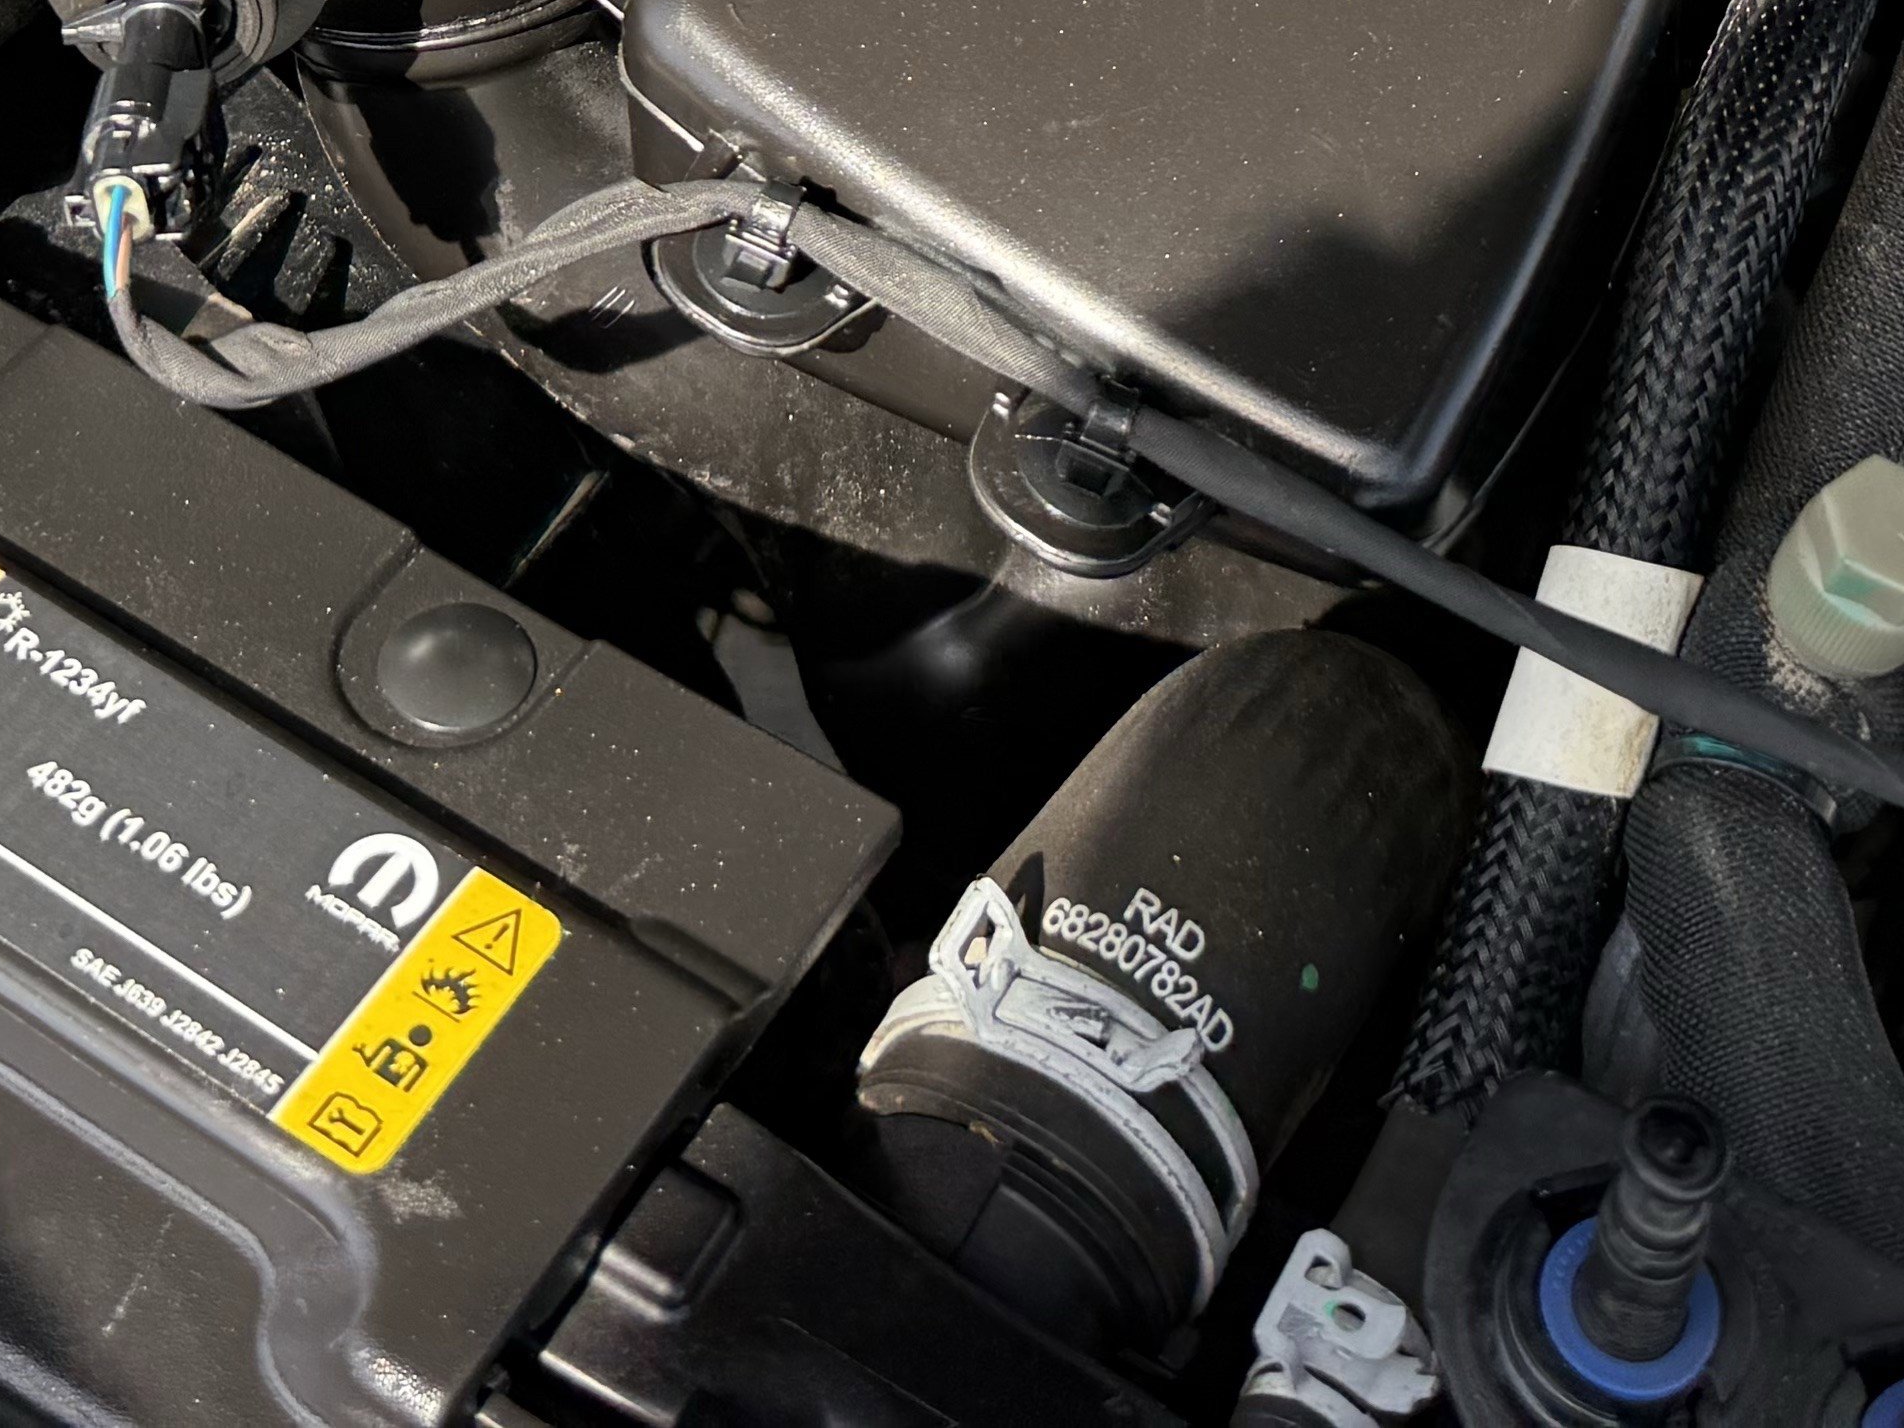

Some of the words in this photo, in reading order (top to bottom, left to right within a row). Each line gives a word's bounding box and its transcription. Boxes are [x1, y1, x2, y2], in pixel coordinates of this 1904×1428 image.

[3, 627, 147, 724] R-1234yf
[26, 761, 107, 827] 482g
[99, 808, 190, 873] (1.06
[180, 856, 253, 920] lbs)
[1042, 897, 1234, 1053] 68280782AD
[1123, 888, 1205, 960] RAD
[70, 948, 122, 989] SAE
[113, 978, 167, 1019] J639
[159, 1007, 226, 1058] J2842
[217, 1046, 285, 1096] J2845
